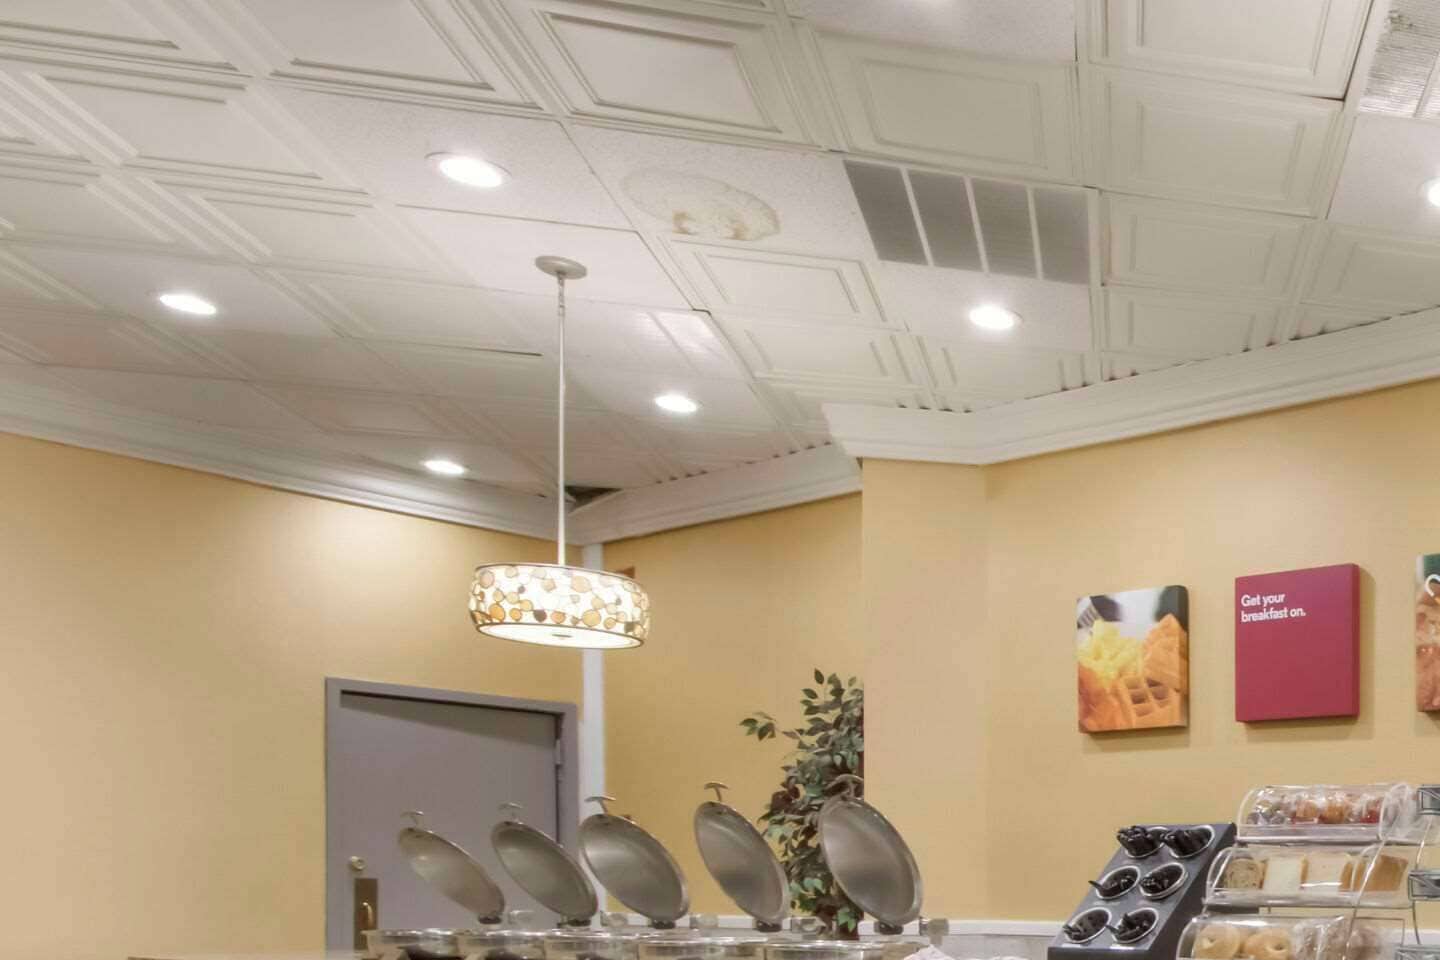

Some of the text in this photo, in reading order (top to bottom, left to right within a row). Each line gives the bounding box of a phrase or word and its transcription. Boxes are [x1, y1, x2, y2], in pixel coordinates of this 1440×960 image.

[1241, 594, 1285, 607] Get your
[1241, 607, 1306, 622] breakfast on.
